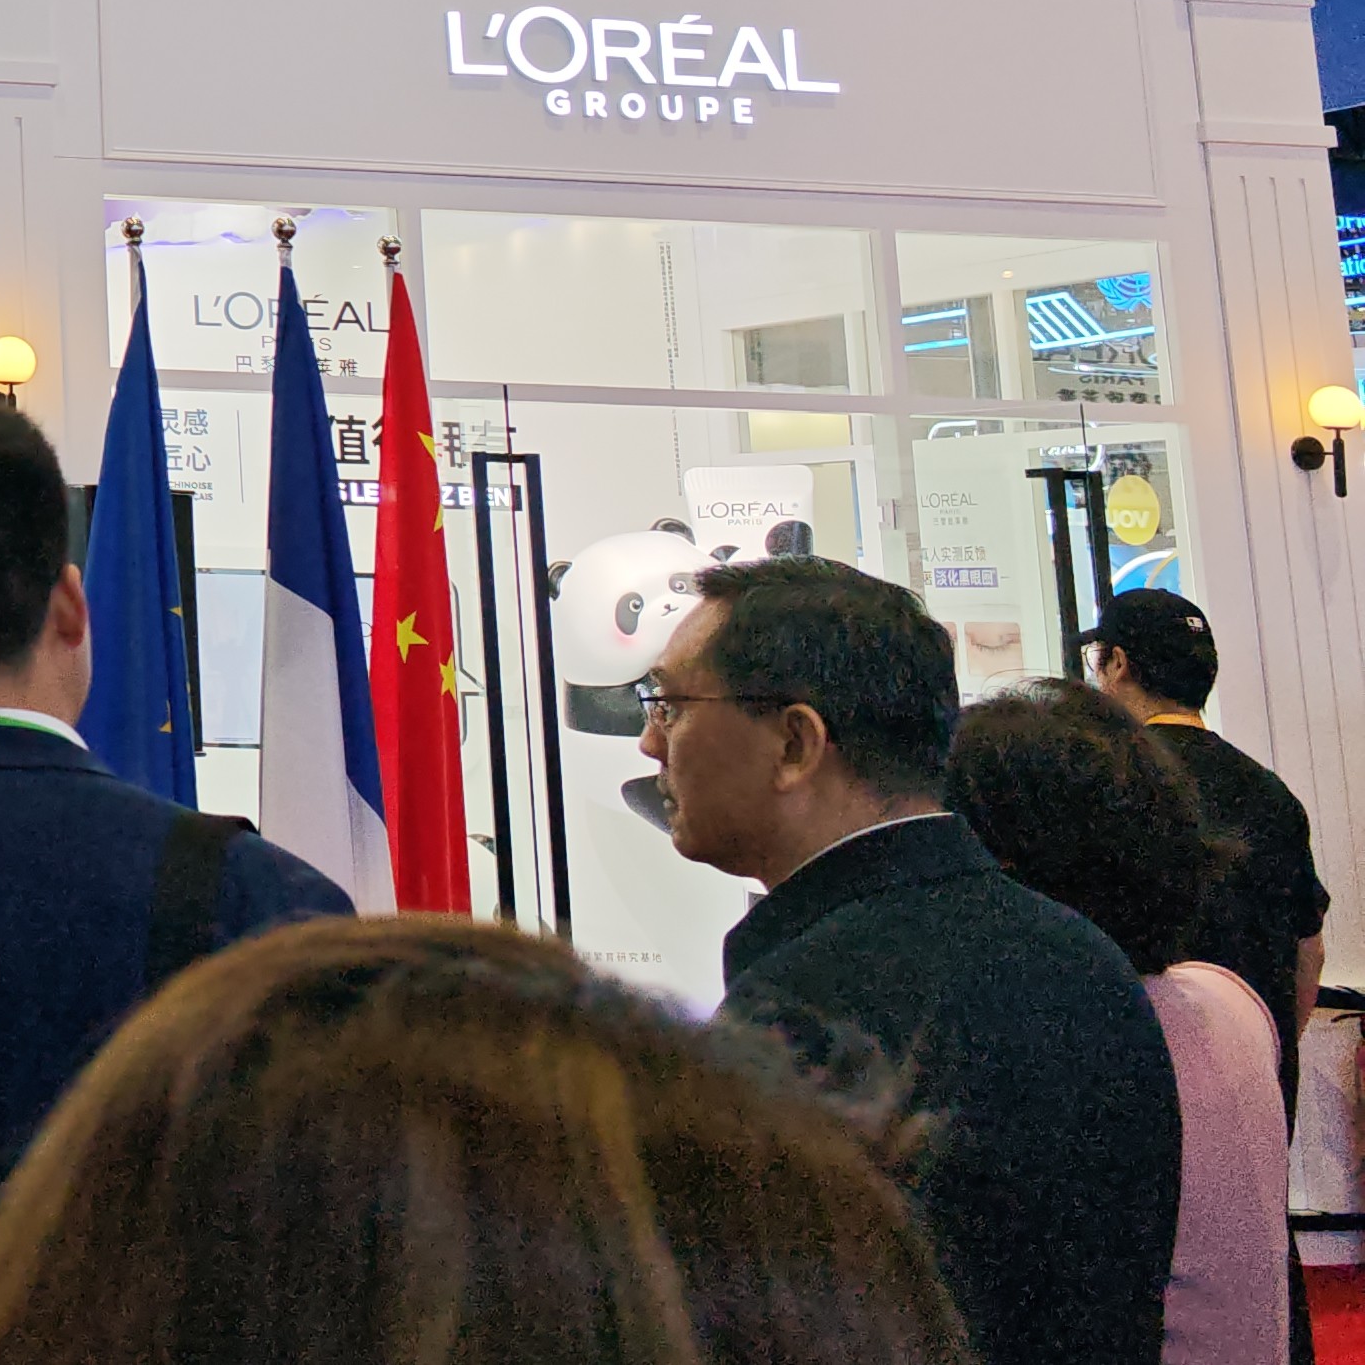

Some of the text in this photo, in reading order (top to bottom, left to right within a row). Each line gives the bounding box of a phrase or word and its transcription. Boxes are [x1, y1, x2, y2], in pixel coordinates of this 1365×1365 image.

[446, 6, 840, 95] L'ORÉAL
[546, 88, 754, 126] GROUPE
[727, 518, 763, 526] PARIS
